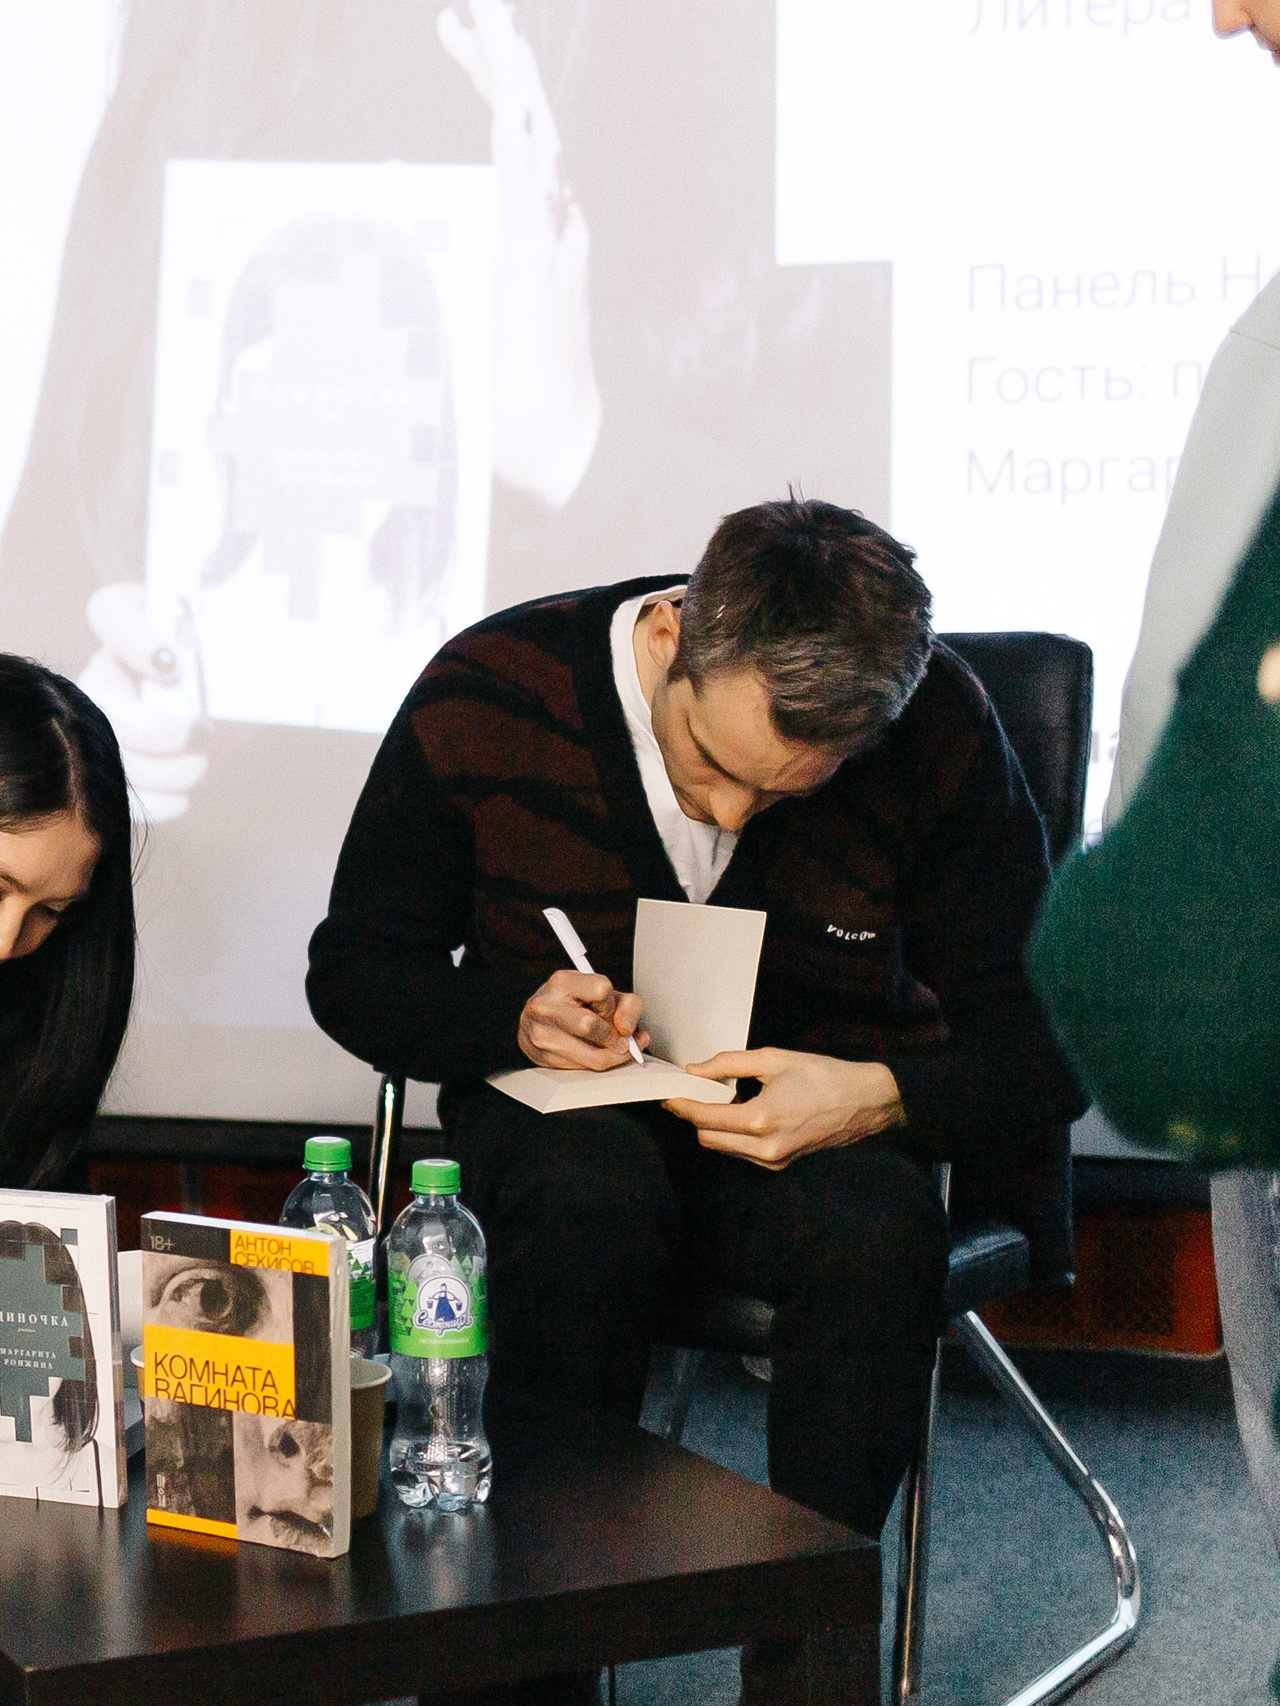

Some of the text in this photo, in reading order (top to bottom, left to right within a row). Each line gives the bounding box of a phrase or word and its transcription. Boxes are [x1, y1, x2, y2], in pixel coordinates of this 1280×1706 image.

[968, 262, 1197, 313] Панель
[968, 356, 1148, 404] Гость:
[150, 1235, 175, 1251] 18+
[234, 1235, 292, 1257] АНТОН
[234, 1252, 315, 1275] СЕКИСОВ
[0, 1347, 56, 1359] МАРГАРИТА
[154, 1352, 279, 1395] КОМНАТА
[154, 1378, 296, 1419] ВАГИНОВА
